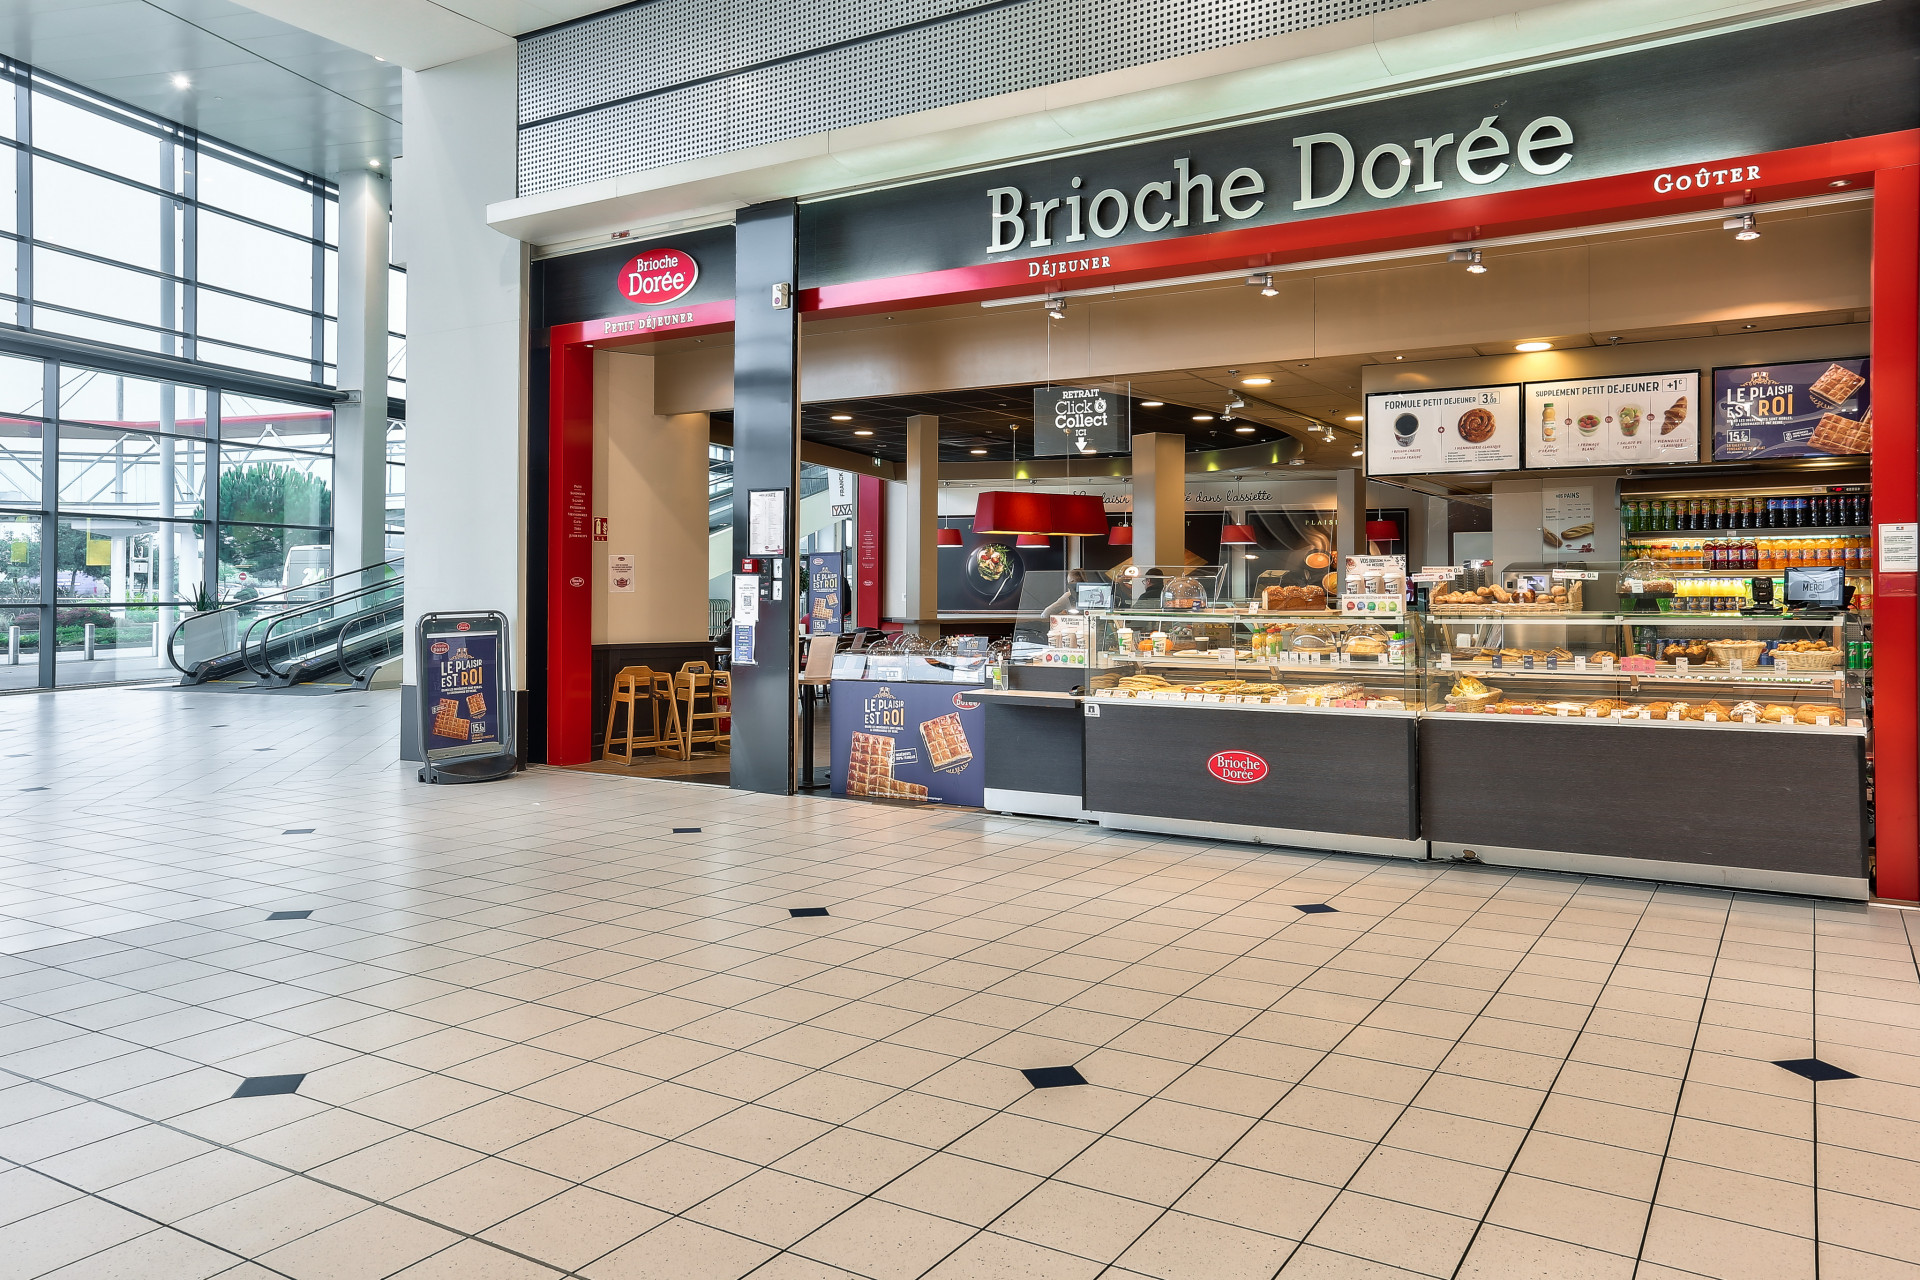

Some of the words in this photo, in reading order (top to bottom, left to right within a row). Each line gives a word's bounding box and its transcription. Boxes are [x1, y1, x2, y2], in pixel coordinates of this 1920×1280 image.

[986, 158, 1265, 254] Brioche
[1293, 115, 1574, 210] Dorée
[1653, 165, 1761, 194] GOÛTER
[637, 254, 678, 273] Brioche
[1028, 256, 1111, 278] DÉJEUNER
[628, 271, 685, 296] Dorée
[604, 320, 635, 334] PETIT
[1062, 388, 1100, 400] RETRAIT
[1582, 385, 1604, 395] PETIT
[1727, 388, 1745, 404] LE
[1750, 385, 1793, 400] PLAISIR
[1055, 399, 1094, 415] Click
[1384, 399, 1421, 410] FORMULE
[1423, 398, 1442, 407] PETIT
[1758, 394, 1793, 416] ROI
[1054, 412, 1108, 429] Collect
[1075, 428, 1087, 437] ICI
[1195, 491, 1222, 503] dans
[1226, 489, 1273, 503] l'assiette
[1564, 491, 1580, 499] PAINS
[813, 573, 820, 582] LE
[813, 581, 823, 589] EST
[825, 577, 837, 588] ROI
[441, 661, 454, 676] LE
[455, 659, 483, 673] PLAISIR
[441, 673, 458, 688] EST
[461, 666, 483, 686] ROI
[864, 698, 876, 713] LE
[878, 699, 904, 711] PLAISIR
[864, 711, 881, 725] EST
[883, 707, 904, 726] ROI
[1217, 755, 1260, 770] Brioche
[1222, 768, 1254, 780] Dorée
